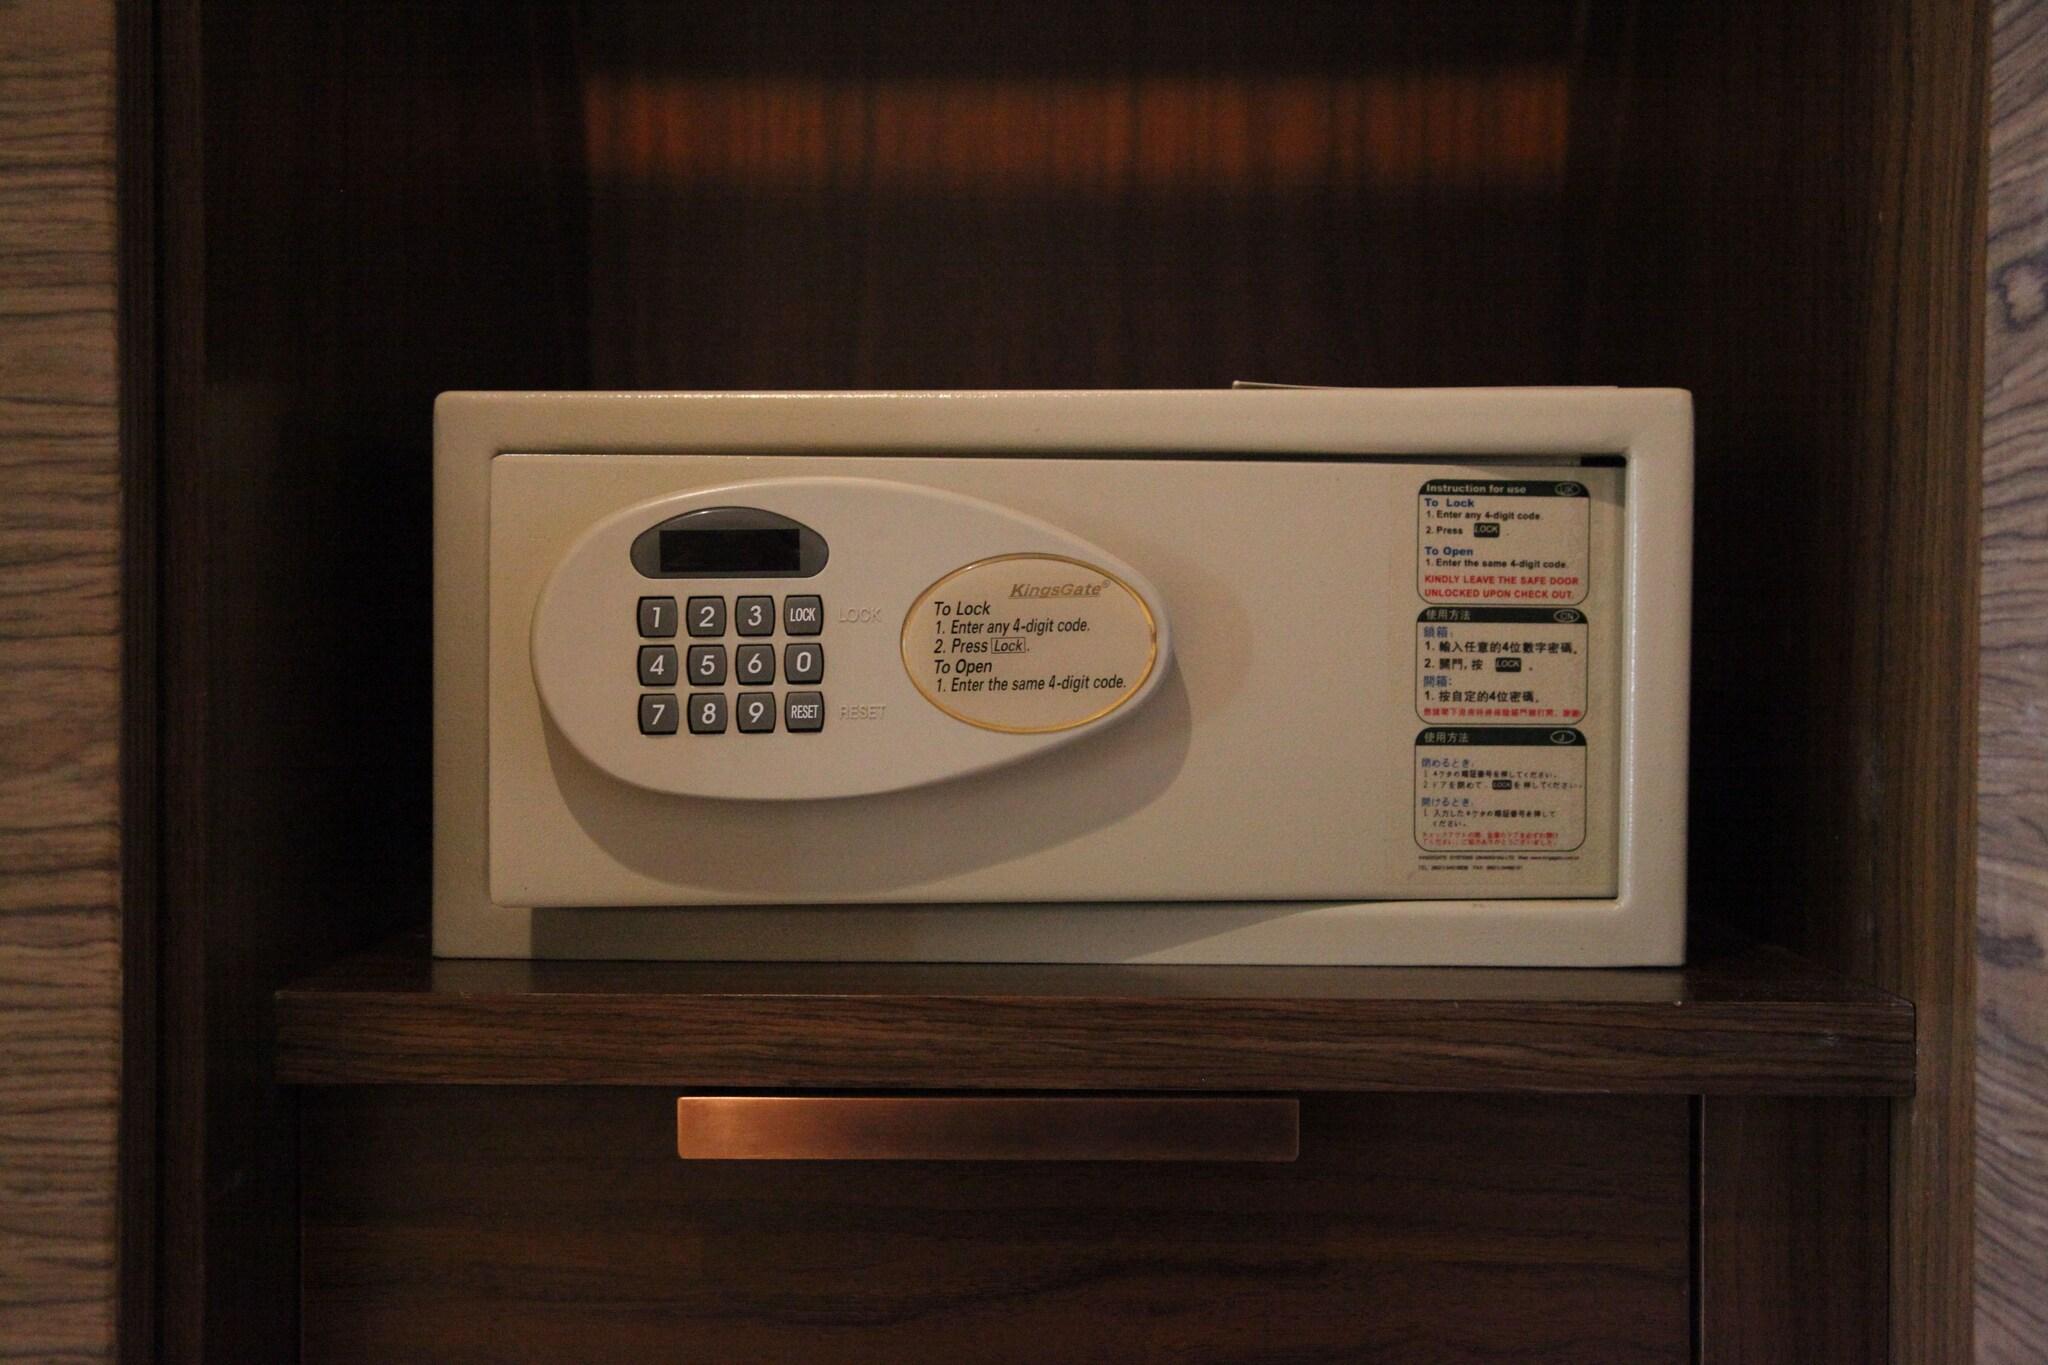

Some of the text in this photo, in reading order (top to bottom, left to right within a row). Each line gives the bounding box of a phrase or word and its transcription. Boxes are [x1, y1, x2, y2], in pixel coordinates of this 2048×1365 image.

[1426, 484, 1486, 493] Instruction
[1489, 485, 1504, 493] for
[1424, 499, 1474, 507] To Lock
[1465, 512, 1481, 520] any
[1485, 512, 1514, 520] 4-digit
[1424, 547, 1473, 556] To Open
[1510, 560, 1540, 569] 4-digit
[1424, 575, 1459, 583] KINDLY
[1498, 576, 1517, 584] THE
[1550, 577, 1579, 585] DOOR
[1483, 590, 1511, 598] UPON
[748, 606, 762, 626] 3
[790, 608, 816, 622] LOCK
[839, 608, 882, 624] LOCK
[934, 602, 990, 616] To Lock
[1426, 610, 1470, 620] 使用方法
[653, 607, 661, 628] 1
[699, 606, 715, 627] 2
[935, 618, 1090, 636] 1. Enter any 4-digit code.
[934, 640, 946, 654] 2.
[952, 639, 988, 653] Press
[1425, 642, 1434, 650] 1.
[650, 655, 665, 675] 4
[700, 655, 715, 675] 5
[748, 653, 762, 673] 6
[796, 652, 812, 672] 0
[935, 659, 992, 676] To Open
[1424, 659, 1434, 668] 2.
[1496, 659, 1520, 667] LOCK
[936, 675, 1127, 692] 1. Enter the same 4-digit code.
[1425, 691, 1434, 699] 1.
[652, 704, 665, 725] 7
[702, 703, 716, 724] 8
[749, 702, 764, 723] 9
[791, 705, 819, 719] RESET
[839, 705, 886, 719] RESET
[1425, 732, 1469, 743] 使用方法
